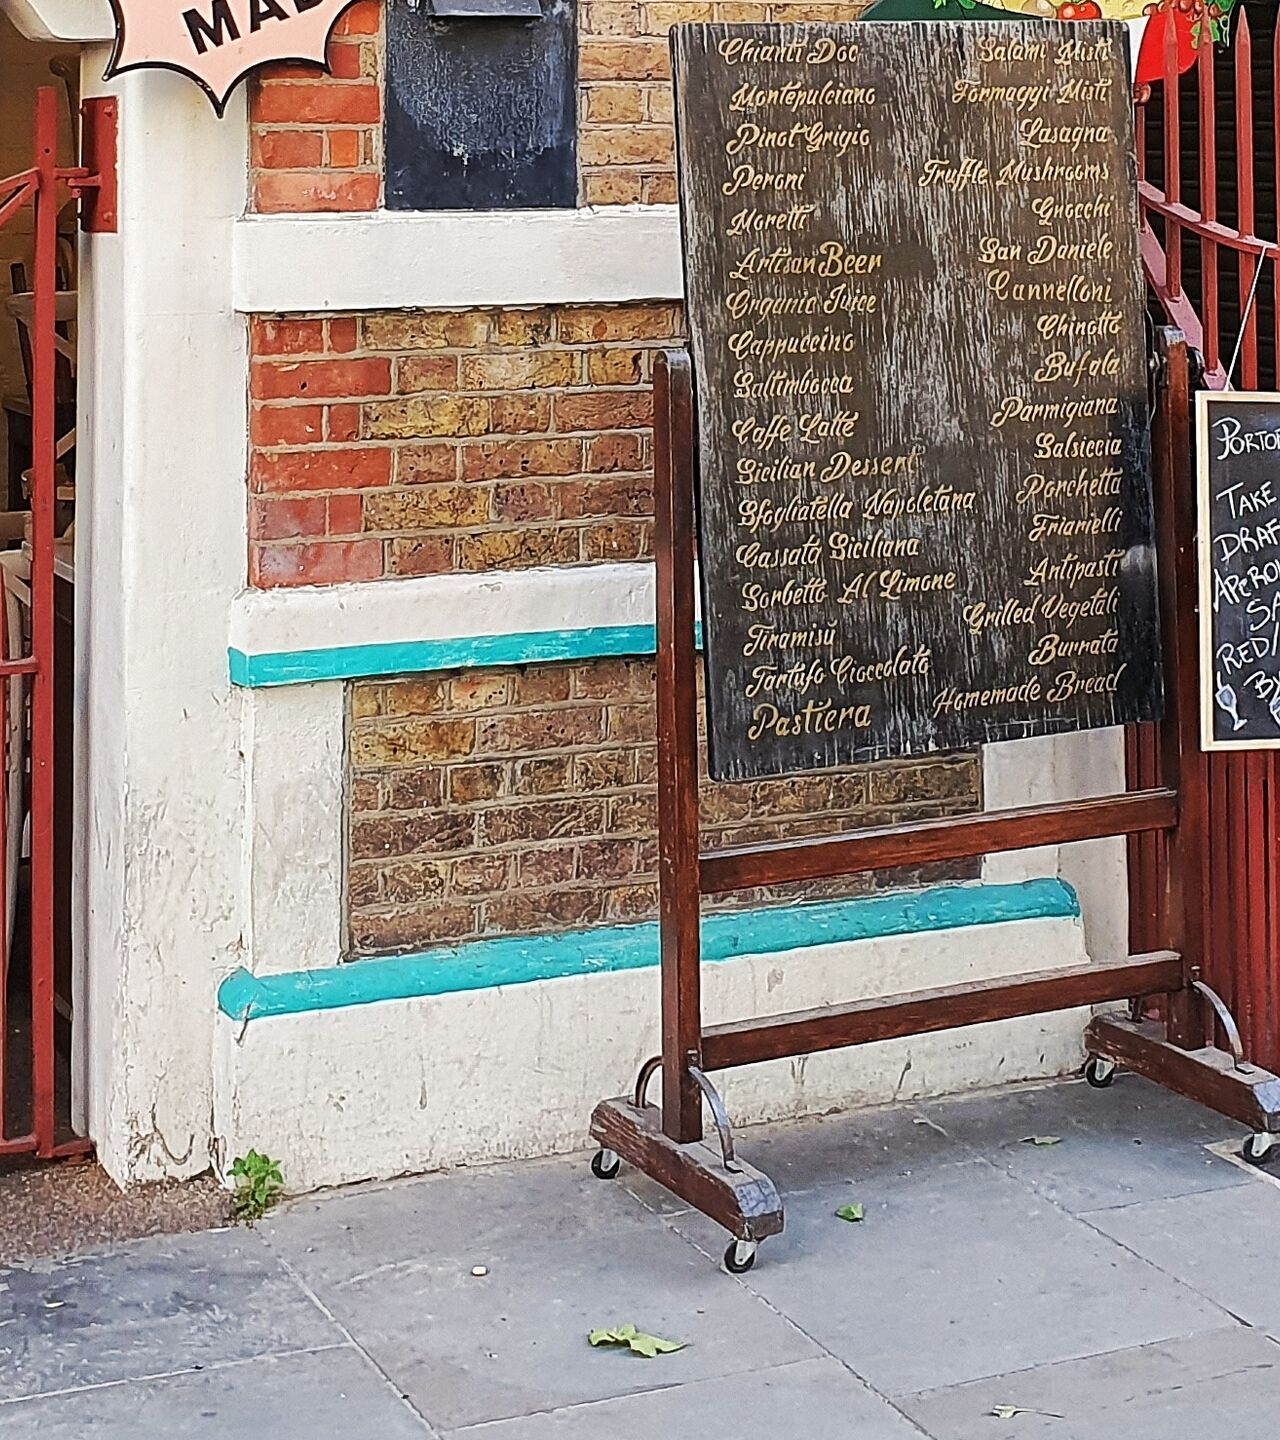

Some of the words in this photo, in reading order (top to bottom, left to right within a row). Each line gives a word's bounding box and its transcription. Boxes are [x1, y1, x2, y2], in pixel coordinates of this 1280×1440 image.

[718, 37, 803, 65] Chianti
[807, 38, 859, 64] Doc
[978, 36, 1047, 62] Salami
[1055, 38, 1113, 64] Misti
[729, 80, 875, 111] Montepulciano
[952, 79, 1051, 111] Formaggi
[1057, 79, 1112, 104] Misti
[726, 123, 808, 155] Pinot
[805, 122, 869, 157] Grigio
[1020, 118, 1110, 152] Lasagna
[723, 164, 806, 195] Peroni
[918, 159, 989, 191] Truffle
[996, 157, 1110, 186] Mushrooms
[726, 204, 816, 237] Moretti
[1032, 193, 1114, 227] Gnocchi
[729, 247, 816, 280] Artisan
[818, 241, 881, 278] Beer
[978, 236, 1022, 263] San
[1027, 233, 1113, 264] Daniele
[726, 289, 816, 324] Organic
[824, 283, 877, 314] Juice
[987, 269, 1112, 303] Cannelloni
[1037, 312, 1122, 340] Chinotto
[728, 327, 854, 362] Cappuccino
[733, 368, 853, 398] Saltimbocca
[1034, 349, 1120, 387] Bufala
[990, 395, 1117, 427] Parmigiana
[732, 415, 791, 450] Caffe
[799, 411, 859, 444] Latte
[1034, 431, 1121, 458] Salsiccia
[735, 456, 816, 485] Sicilian
[820, 443, 926, 483] Dessert
[1016, 469, 1123, 504] Porchetta
[1216, 481, 1278, 519] TAKE
[738, 492, 853, 533] Sfogliatella
[863, 485, 976, 520] Napoletana
[1029, 508, 1123, 542] Friarielli
[736, 534, 822, 569] Cassata
[829, 529, 920, 560] Siciliana
[1024, 549, 1125, 589] Antipasti
[741, 578, 828, 611] Sorbetto
[837, 571, 876, 604] Al
[880, 569, 956, 600] Limone
[963, 594, 1042, 636] Grilled
[1041, 586, 1120, 629] Vegetali
[1028, 628, 1119, 665] Burrata
[746, 660, 826, 698] Tartufo
[830, 644, 931, 685] Cioccolato
[933, 676, 1040, 718] Homemade
[1046, 663, 1127, 703] Bread
[748, 698, 872, 740] Pastiera
